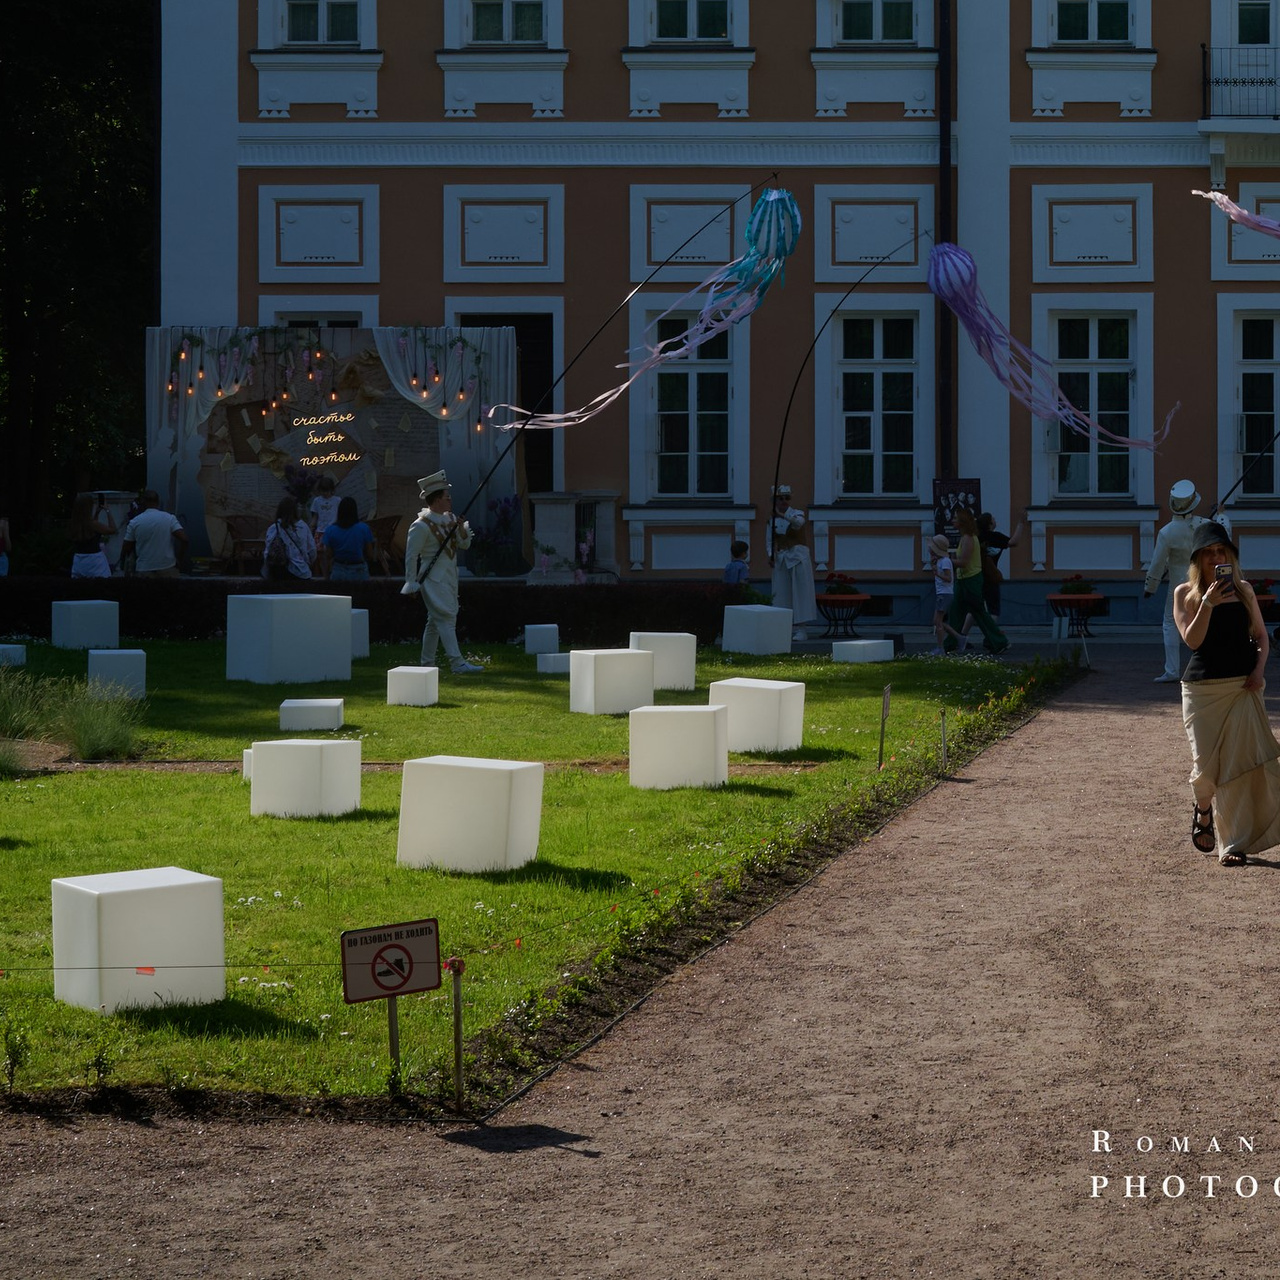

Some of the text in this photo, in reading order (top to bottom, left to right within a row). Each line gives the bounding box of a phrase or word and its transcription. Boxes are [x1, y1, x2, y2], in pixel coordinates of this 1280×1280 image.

[292, 412, 355, 427] счастье
[306, 430, 345, 445] быть
[299, 451, 361, 466] поэтом
[347, 926, 433, 948] ПО ГАЗОНАМ НЕ ХОДИТЬ
